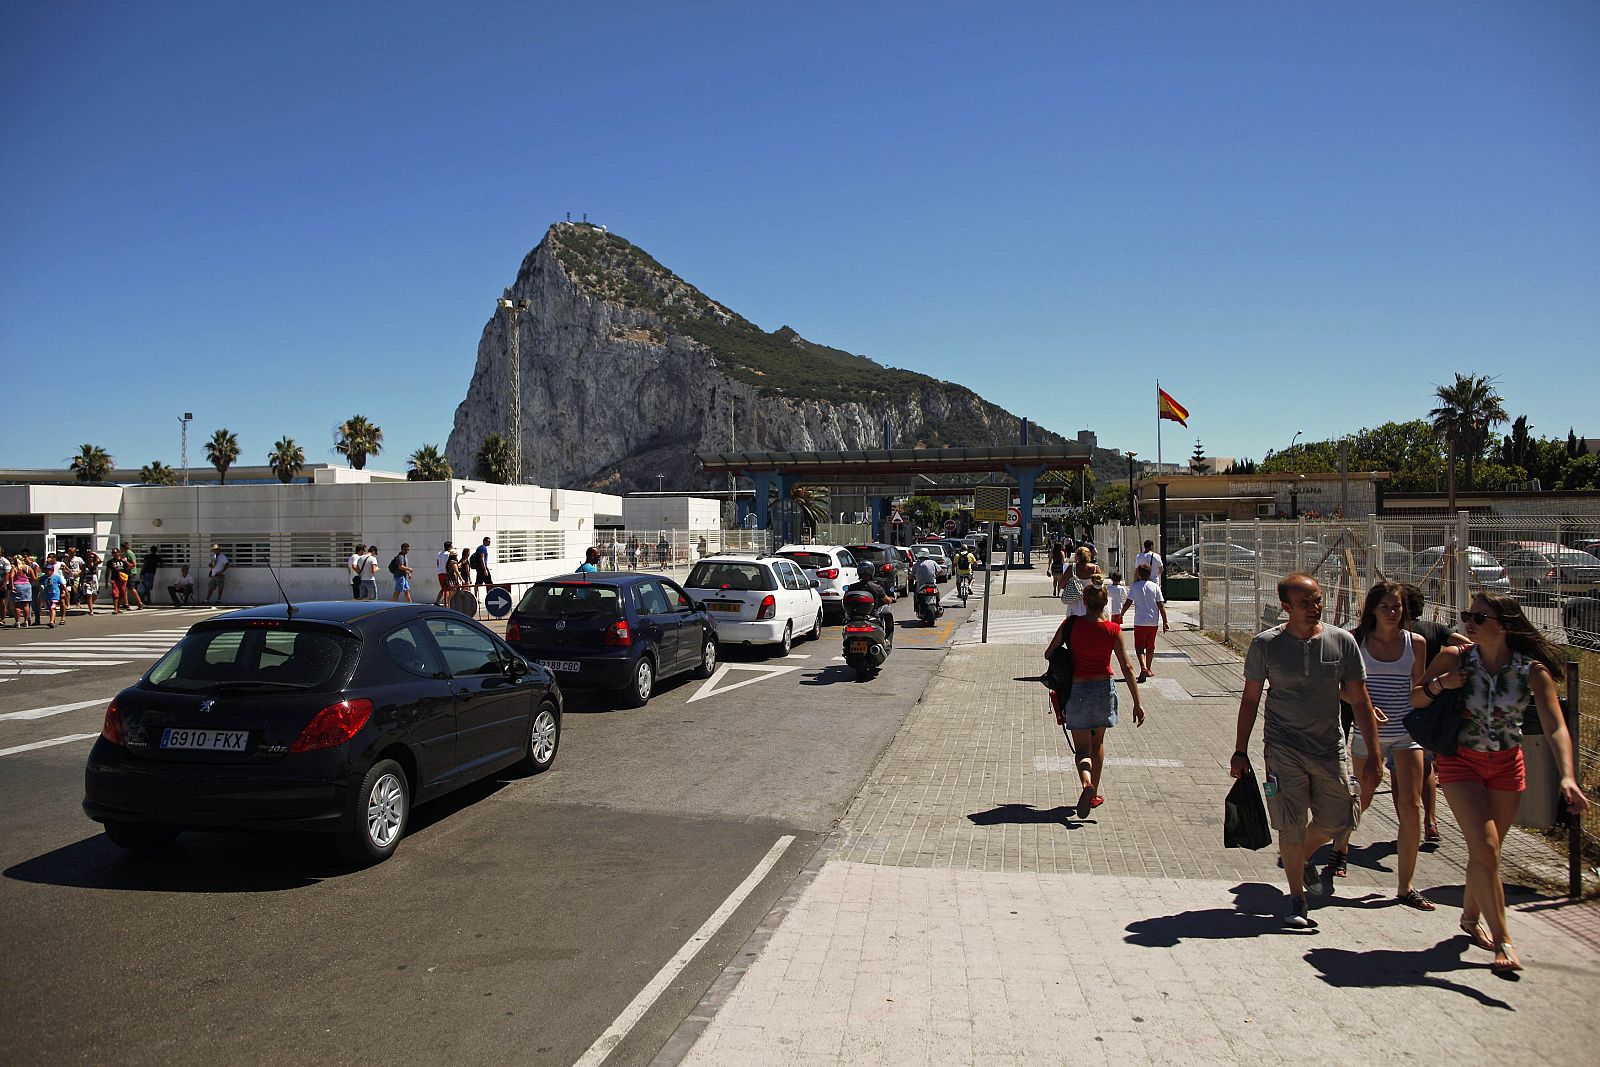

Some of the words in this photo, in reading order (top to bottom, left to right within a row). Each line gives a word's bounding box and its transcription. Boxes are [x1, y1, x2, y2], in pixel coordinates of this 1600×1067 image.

[1007, 513, 1018, 522] 20
[562, 662, 579, 671] CBC
[169, 731, 206, 747] 6910
[213, 732, 244, 749] FKX
